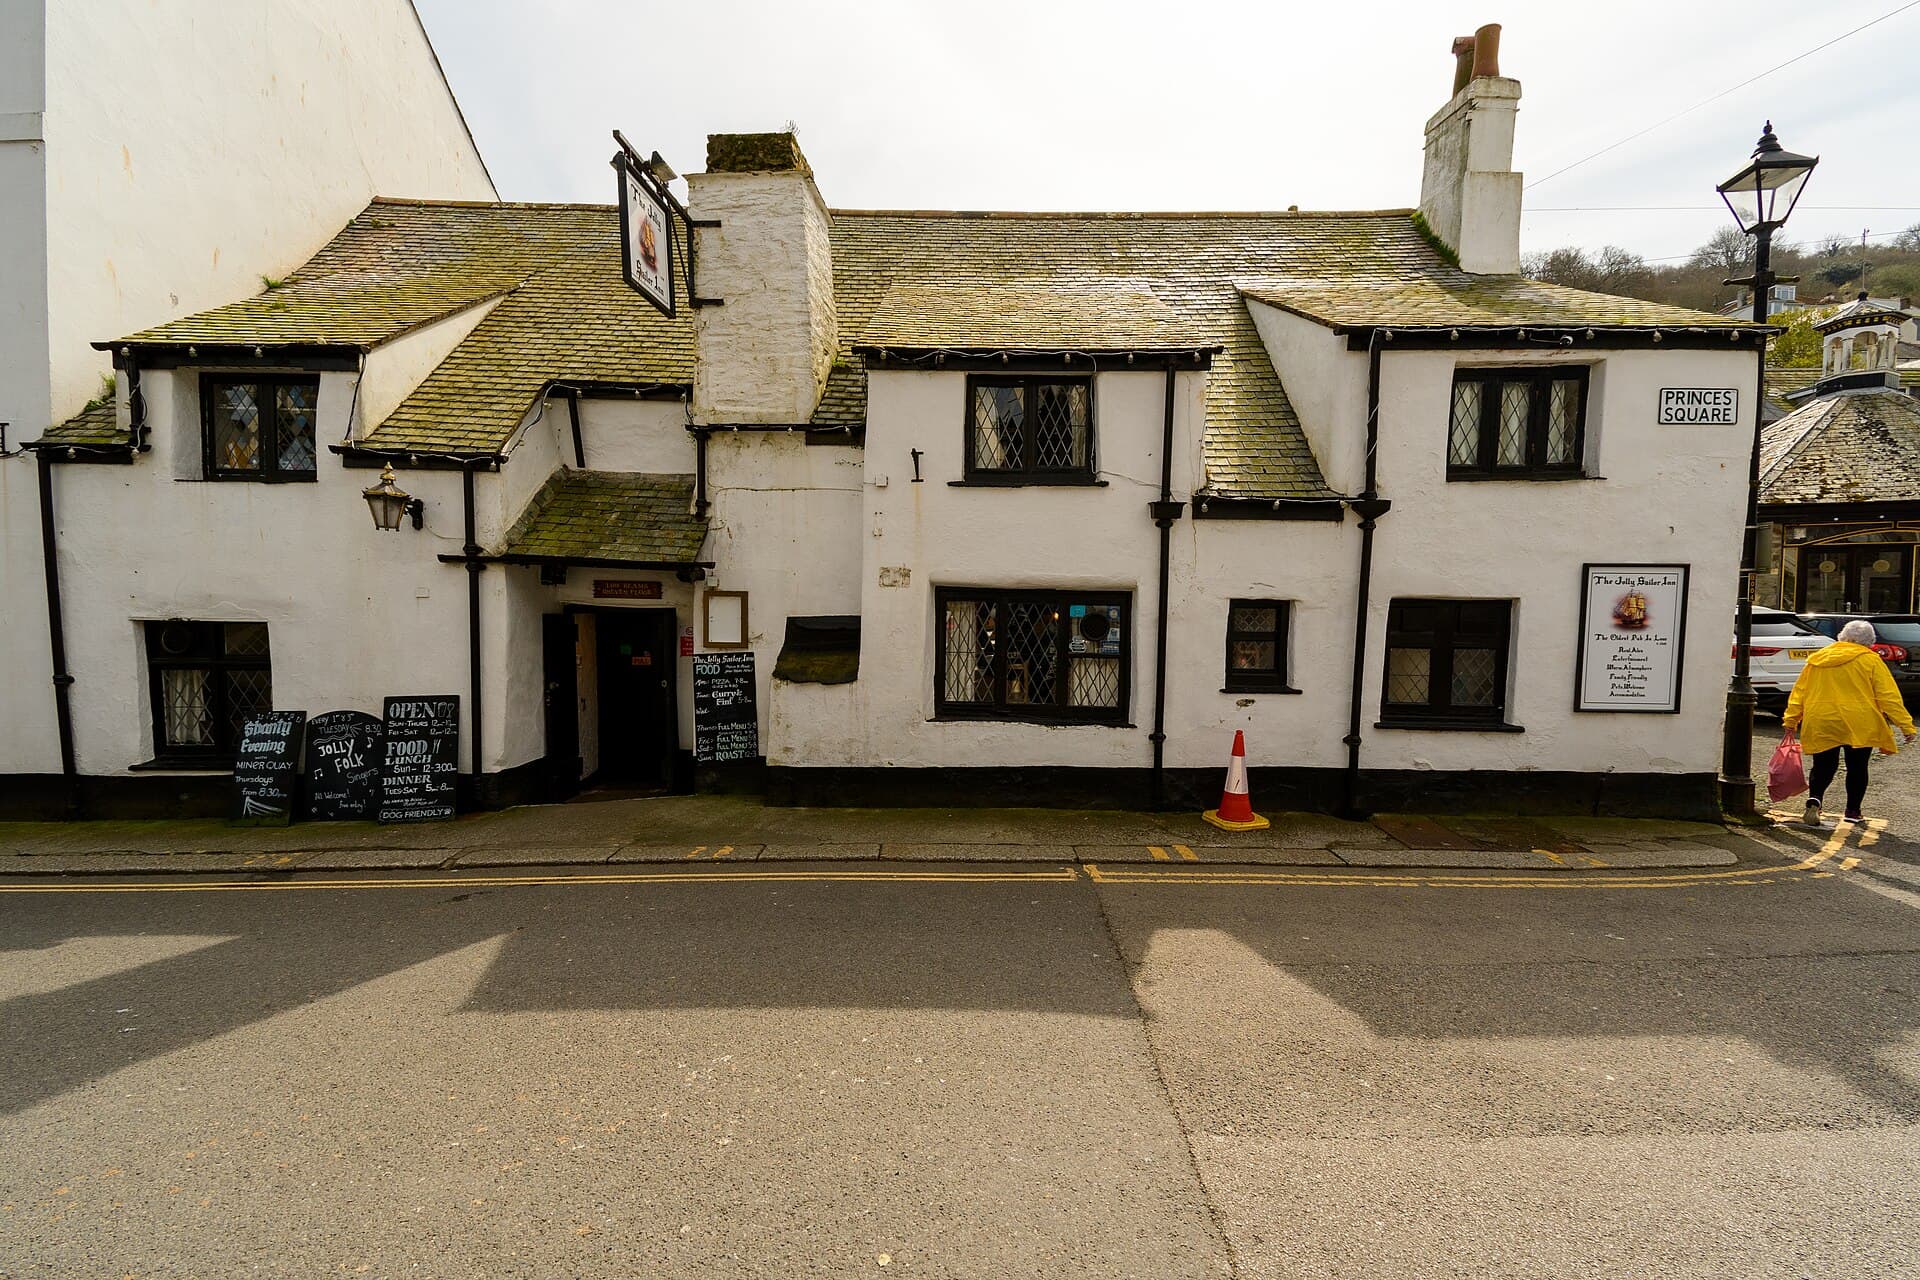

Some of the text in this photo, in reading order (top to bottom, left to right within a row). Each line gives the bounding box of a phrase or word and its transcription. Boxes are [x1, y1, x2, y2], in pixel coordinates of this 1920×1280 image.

[631, 184, 662, 232] The Jolly
[636, 260, 664, 296] Sailor Inn
[1664, 391, 1732, 405] PRINCES
[1664, 407, 1732, 422] SQUARE
[1594, 576, 1676, 588] The Jolly Sailor Inn
[1595, 633, 1608, 641] The
[696, 665, 720, 674] FOOD
[712, 691, 736, 699] Curry
[390, 702, 437, 718] OPEN
[318, 724, 350, 735] TUESDAY
[240, 738, 286, 754] Evening
[318, 739, 354, 757] JOLLY
[386, 740, 429, 756] FOOD
[385, 754, 432, 765] LUNCH
[715, 750, 743, 761] ROAST
[334, 753, 364, 773] FOLK
[235, 774, 274, 786] Thursdays
[346, 768, 379, 786] Singers
[382, 775, 432, 786] DINNER
[242, 788, 257, 796] from
[383, 808, 444, 819] DOG FRIENDLY
